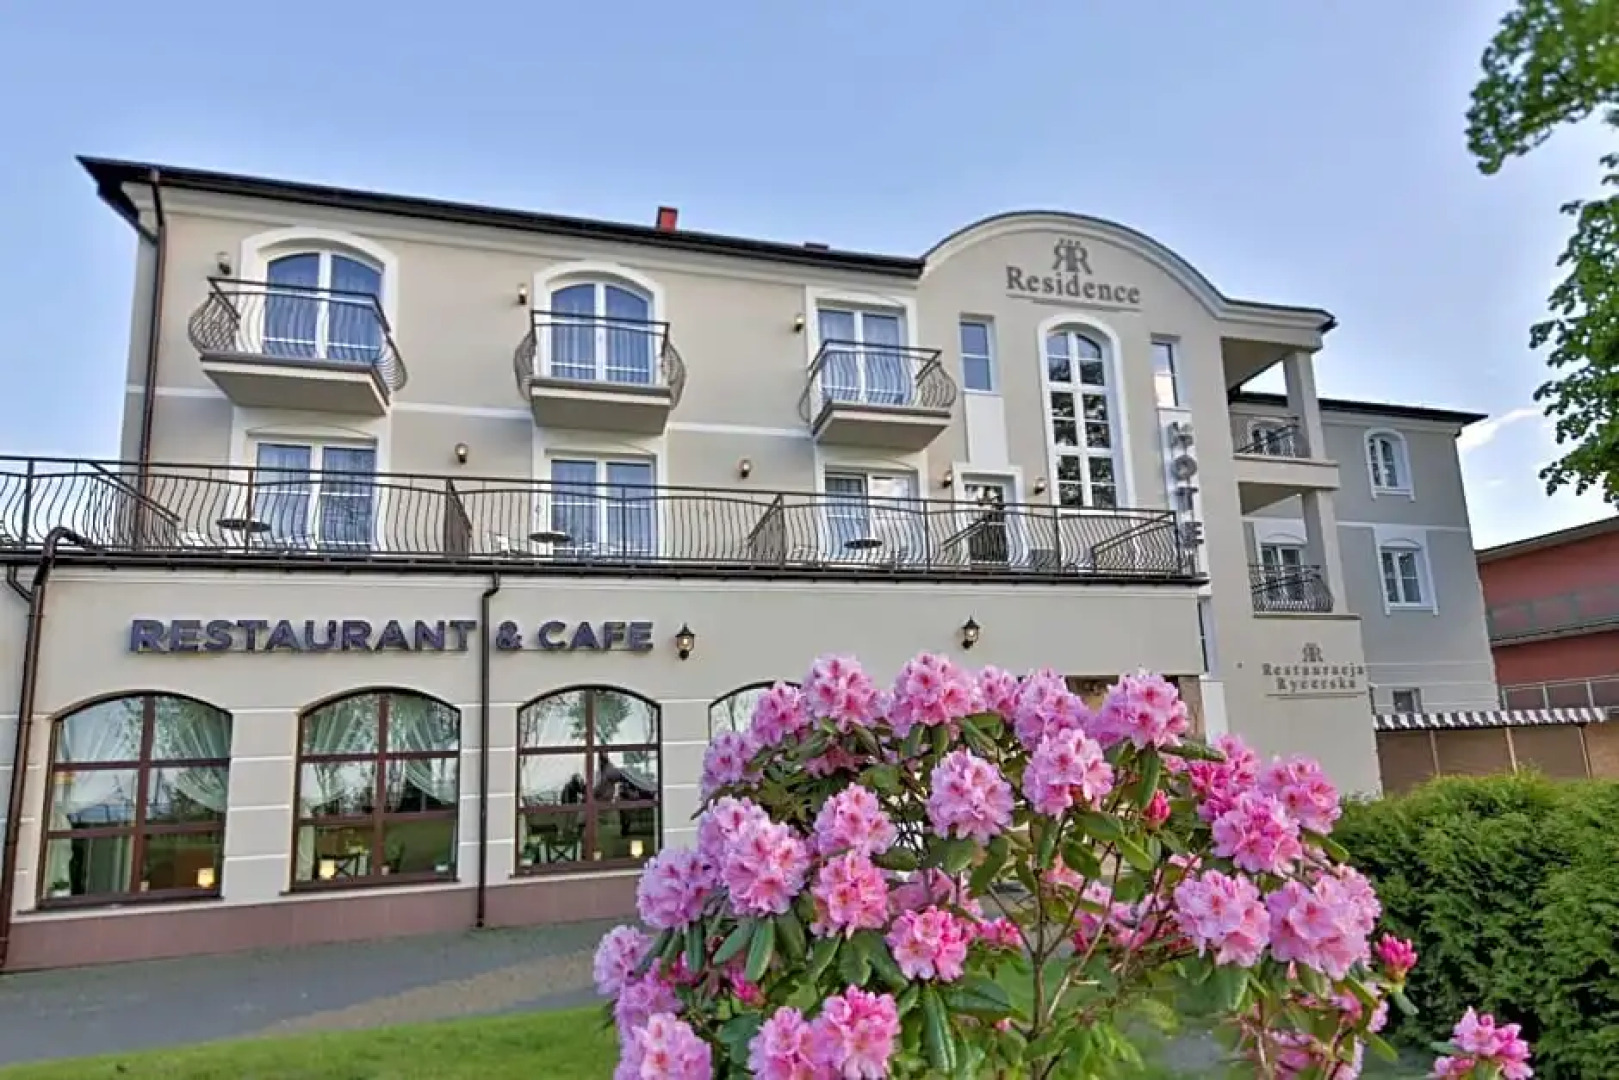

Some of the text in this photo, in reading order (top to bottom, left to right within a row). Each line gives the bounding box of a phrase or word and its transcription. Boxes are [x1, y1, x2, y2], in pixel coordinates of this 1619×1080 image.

[1006, 266, 1140, 303] Residence
[130, 619, 654, 652] RESTAURANT & CAFE
[1262, 663, 1364, 677] Restauracja
[1277, 677, 1356, 692] Rycerska
